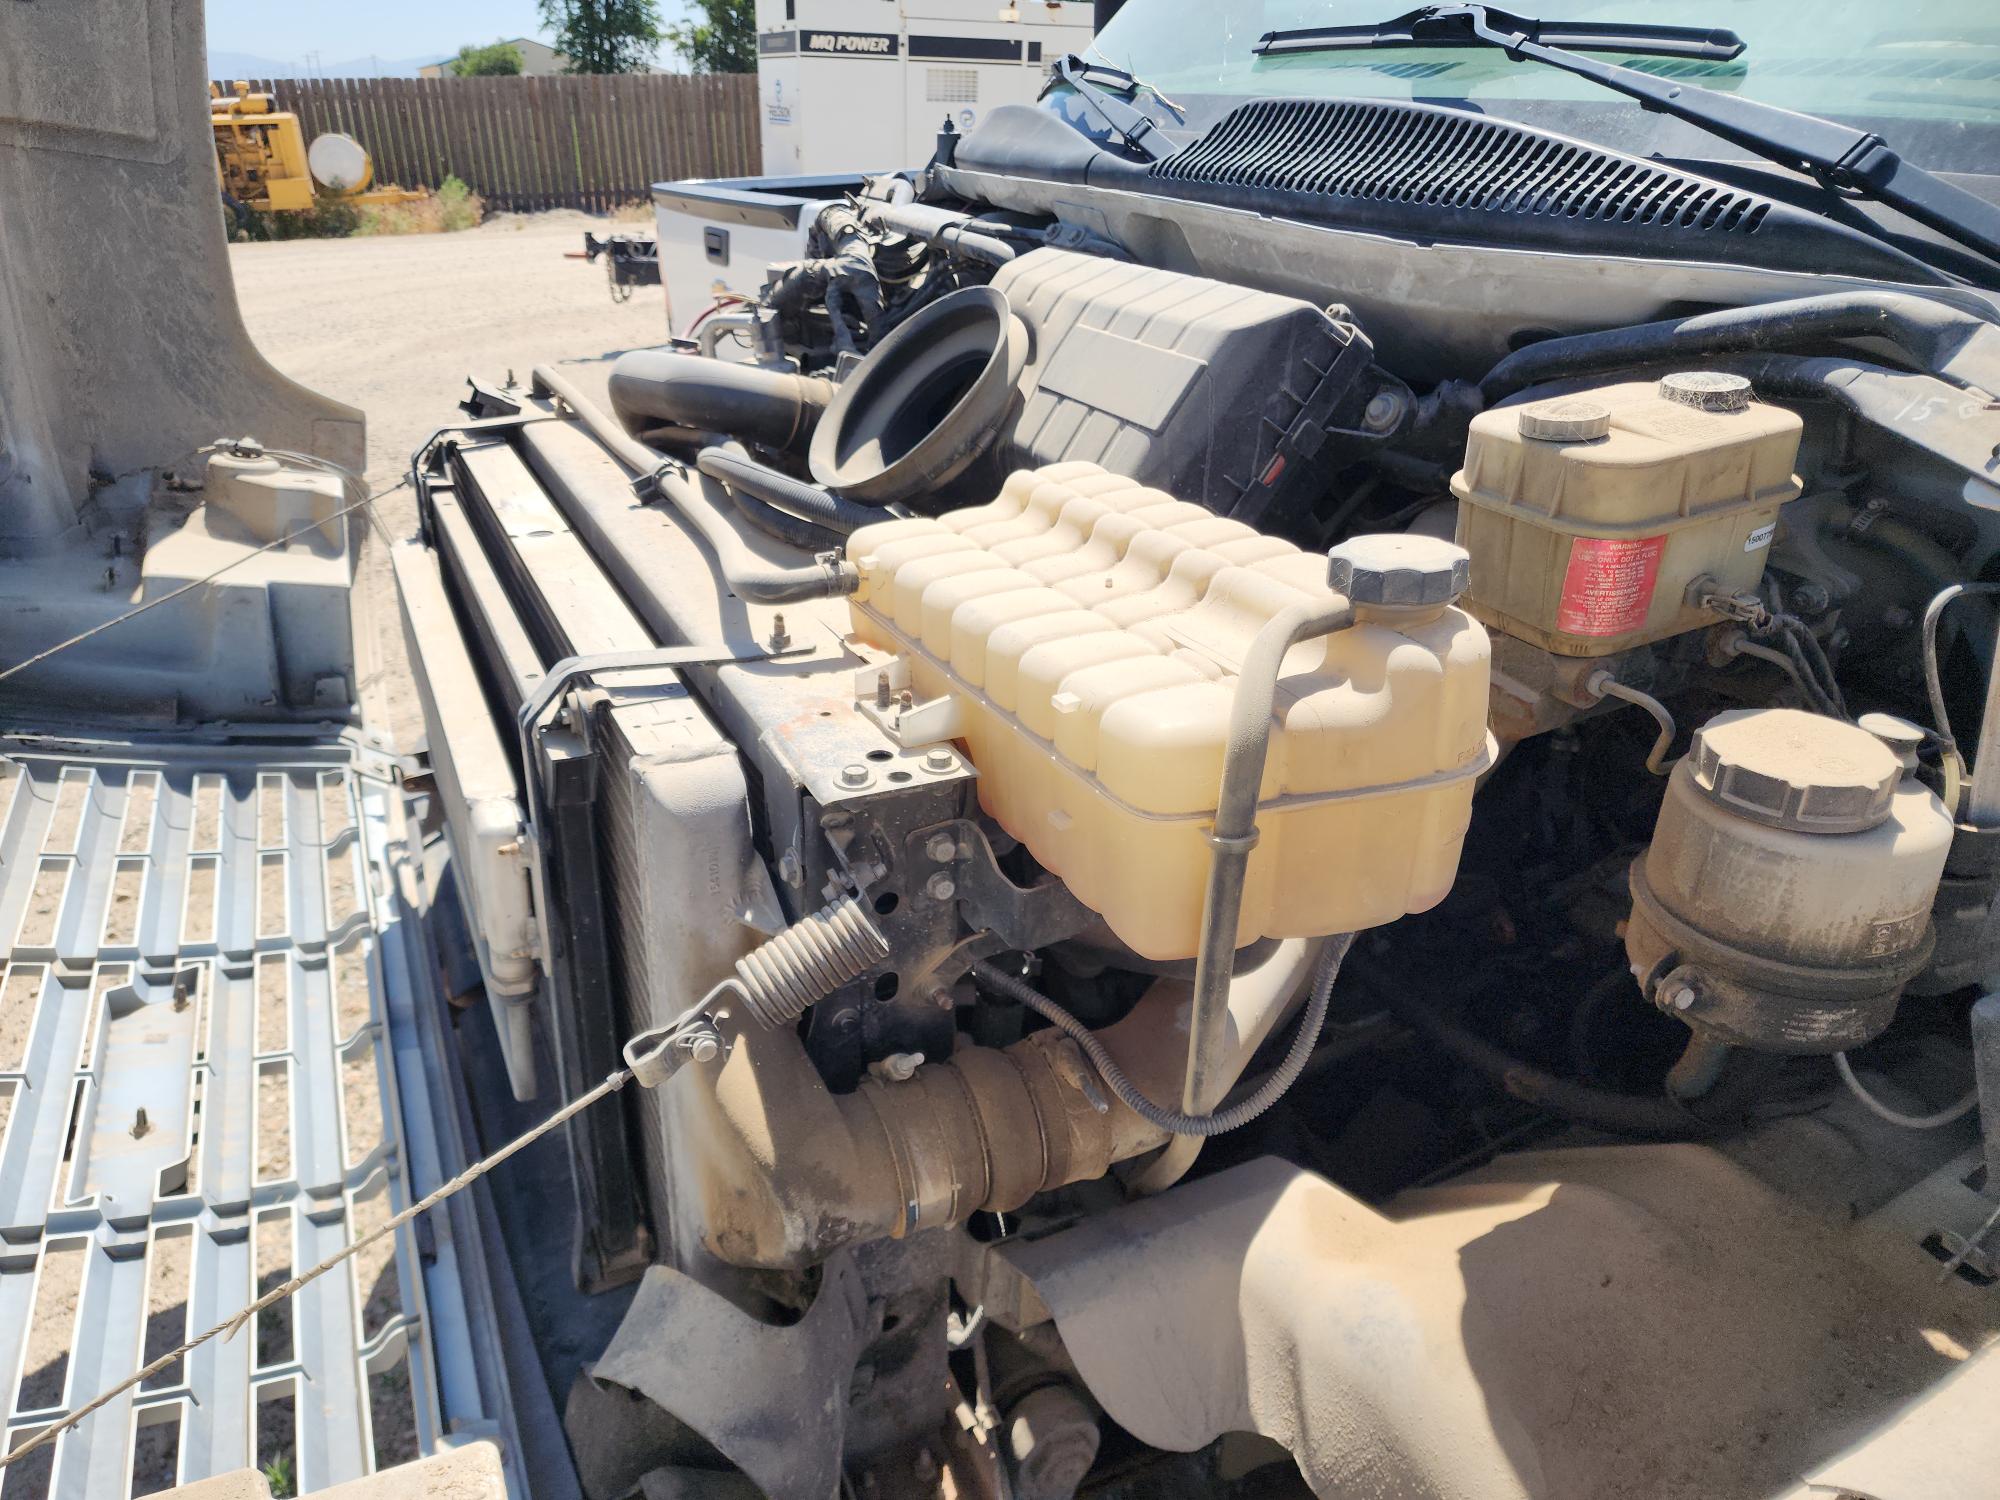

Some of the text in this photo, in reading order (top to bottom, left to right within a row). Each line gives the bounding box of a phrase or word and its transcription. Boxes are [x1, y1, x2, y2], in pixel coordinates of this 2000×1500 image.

[810, 35, 890, 52] MQ POWER
[1610, 543, 1642, 551] WARNING
[1584, 588, 1640, 597] AVERTISSEMENT
